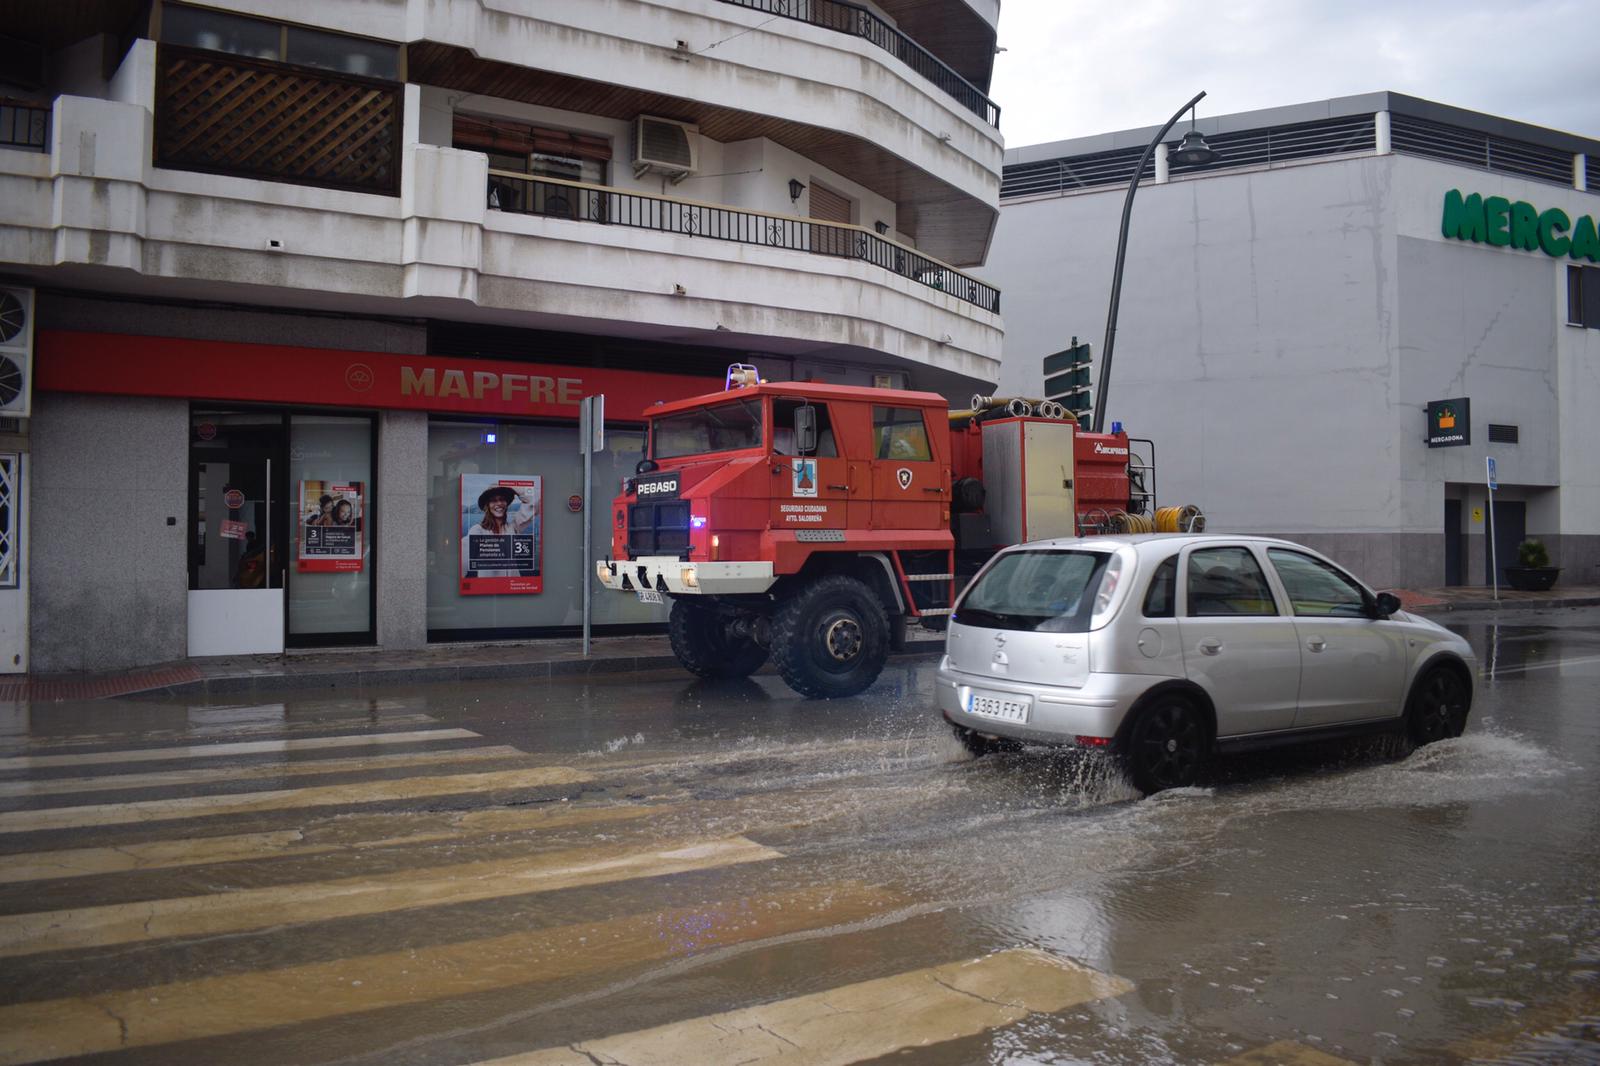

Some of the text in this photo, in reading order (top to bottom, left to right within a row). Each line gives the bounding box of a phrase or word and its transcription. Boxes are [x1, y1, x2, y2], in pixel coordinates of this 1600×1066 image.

[1442, 189, 1600, 262] MERCA
[401, 366, 583, 405] MAPFRE
[1431, 435, 1463, 443] MERCADONA
[638, 480, 677, 495] PEGASO
[780, 504, 827, 513] SEGURIDAD CIUDADANA
[798, 514, 823, 522] SALOBREÑA
[311, 530, 317, 538] 3
[974, 697, 1025, 720] 3363 FFX
